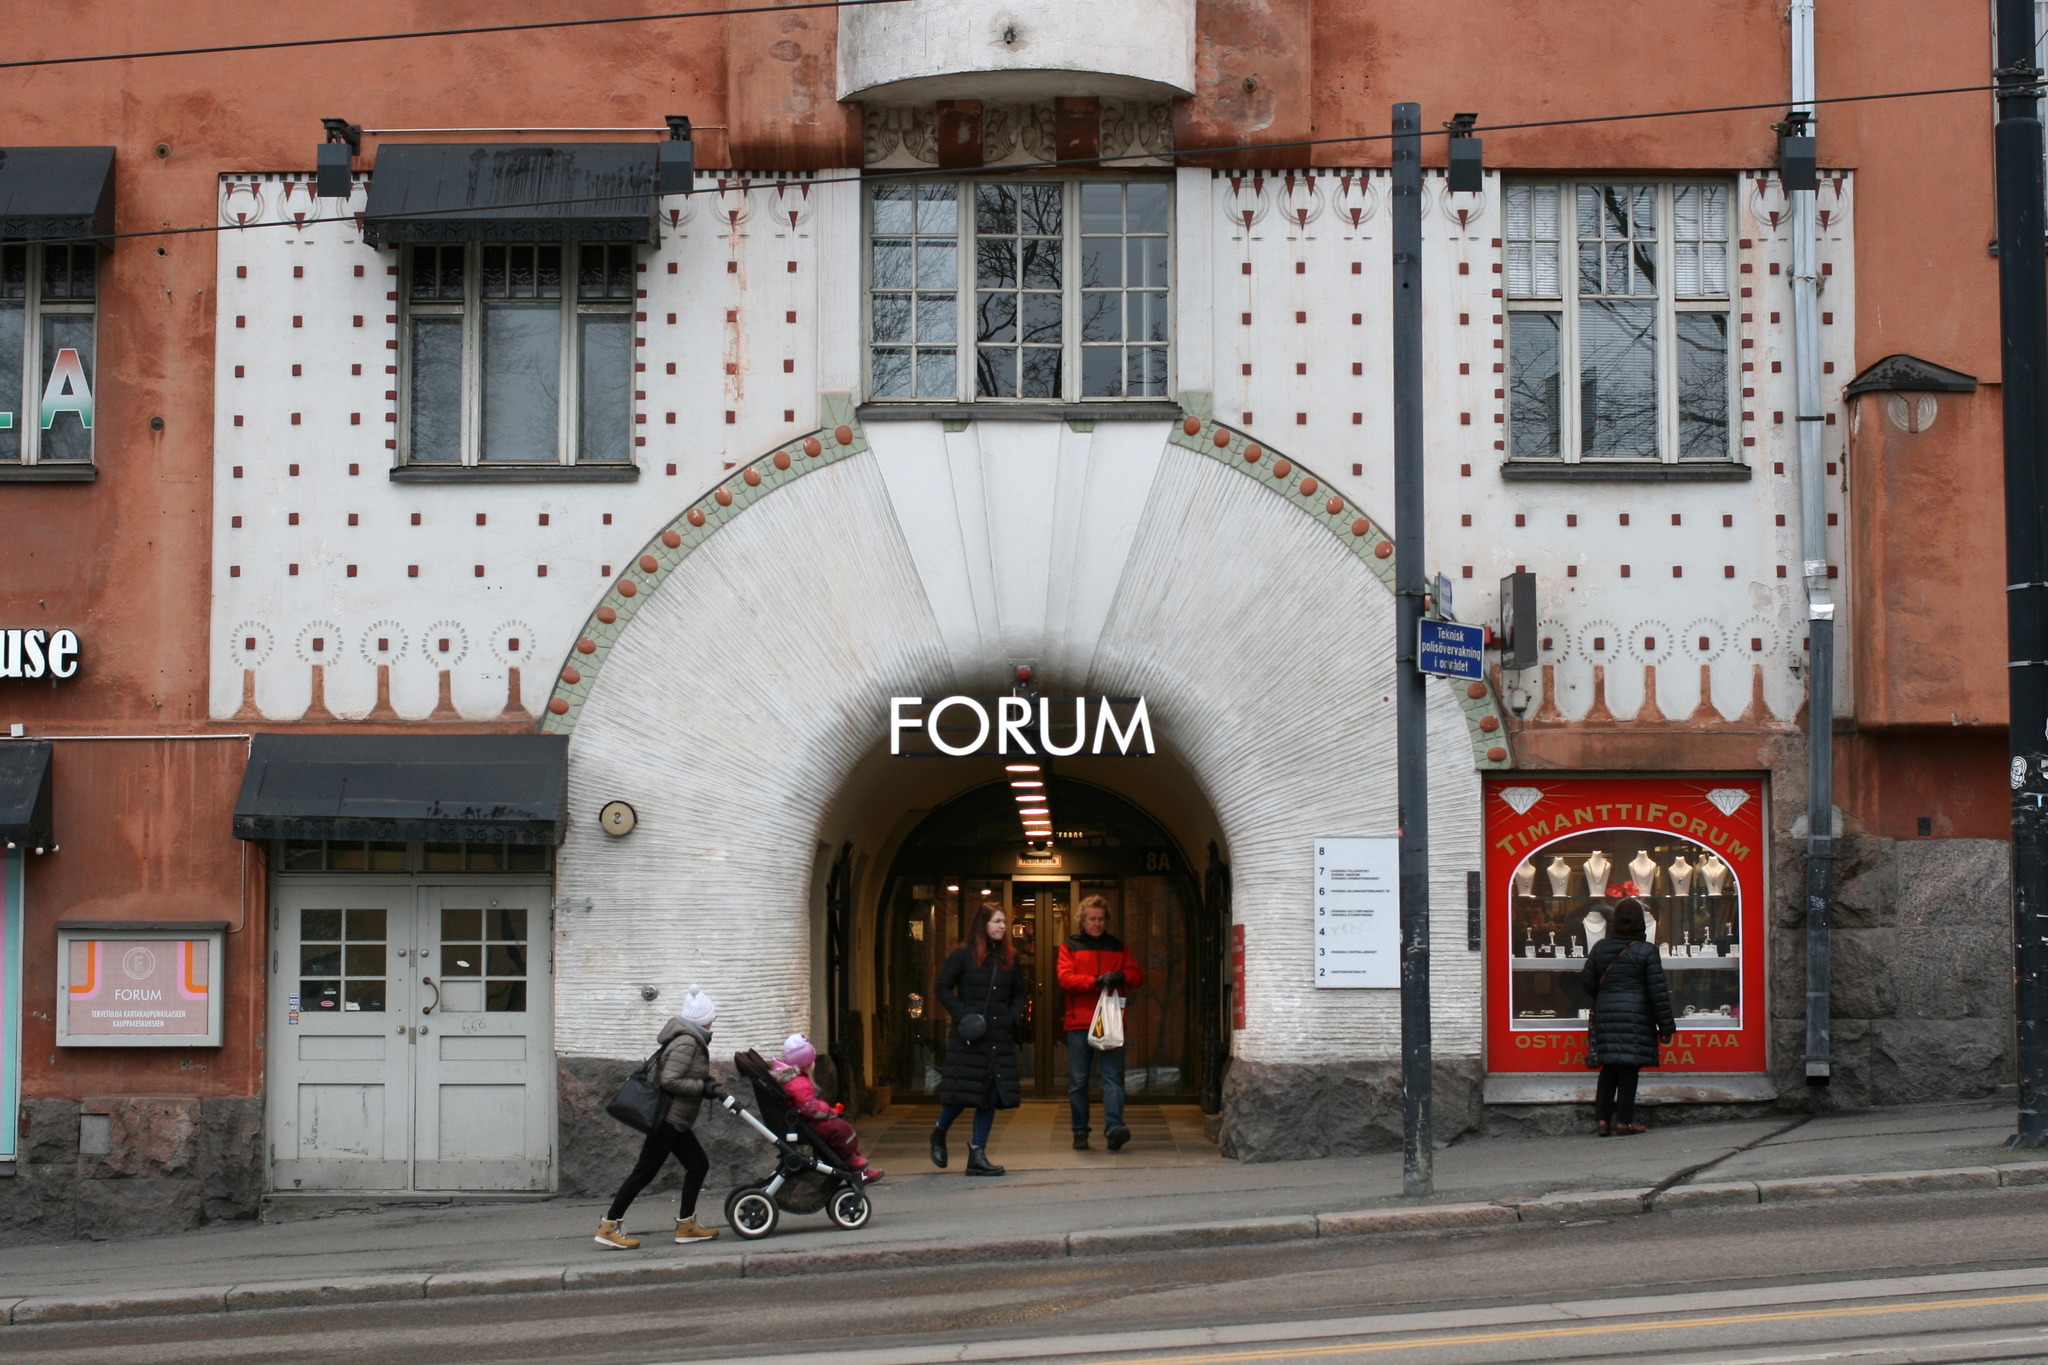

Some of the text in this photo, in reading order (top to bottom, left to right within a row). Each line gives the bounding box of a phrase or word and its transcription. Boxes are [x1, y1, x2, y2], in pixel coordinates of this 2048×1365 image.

[0, 348, 92, 429] A
[1437, 627, 1464, 642] Teknisk
[0, 629, 78, 678] use
[1421, 641, 1481, 661] polisövervakning
[1434, 656, 1437, 668] i
[890, 695, 1156, 755] FORUM
[1319, 847, 1324, 855] 8
[1146, 852, 1171, 871] 8A
[1320, 867, 1324, 875] 7
[1319, 887, 1325, 895] 6
[1320, 907, 1325, 916] 5
[1320, 948, 1325, 956] 3
[1319, 968, 1325, 976] 2
[115, 989, 162, 1000] FORUM
[92, 1010, 122, 1018] TERVETULOA
